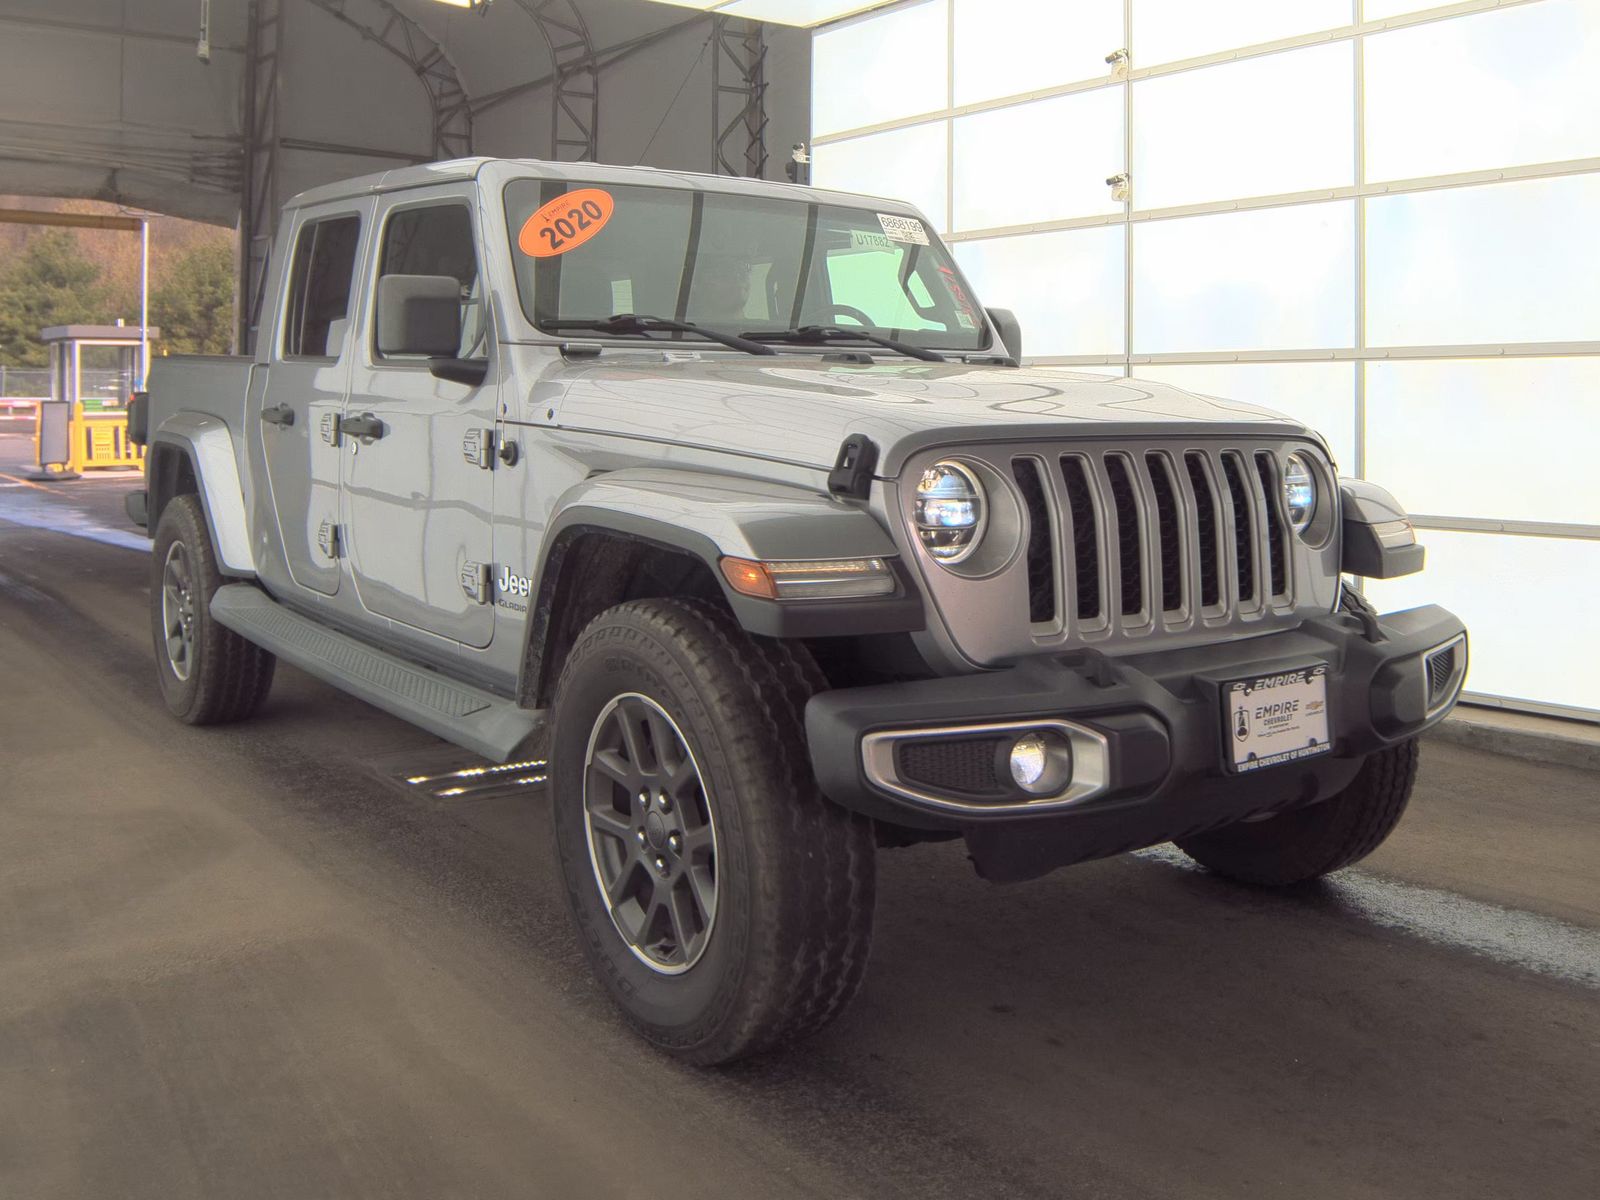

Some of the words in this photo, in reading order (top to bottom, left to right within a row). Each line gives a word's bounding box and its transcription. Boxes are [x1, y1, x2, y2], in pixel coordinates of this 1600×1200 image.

[539, 200, 603, 250] 2020
[880, 216, 923, 233] 6868199
[498, 598, 527, 613] GLADIA
[1254, 671, 1306, 690] EMPIRE
[1255, 699, 1300, 720] EMPIRE
[1263, 714, 1294, 726] CHEVROLET
[1259, 753, 1290, 767] CHEVROLET
